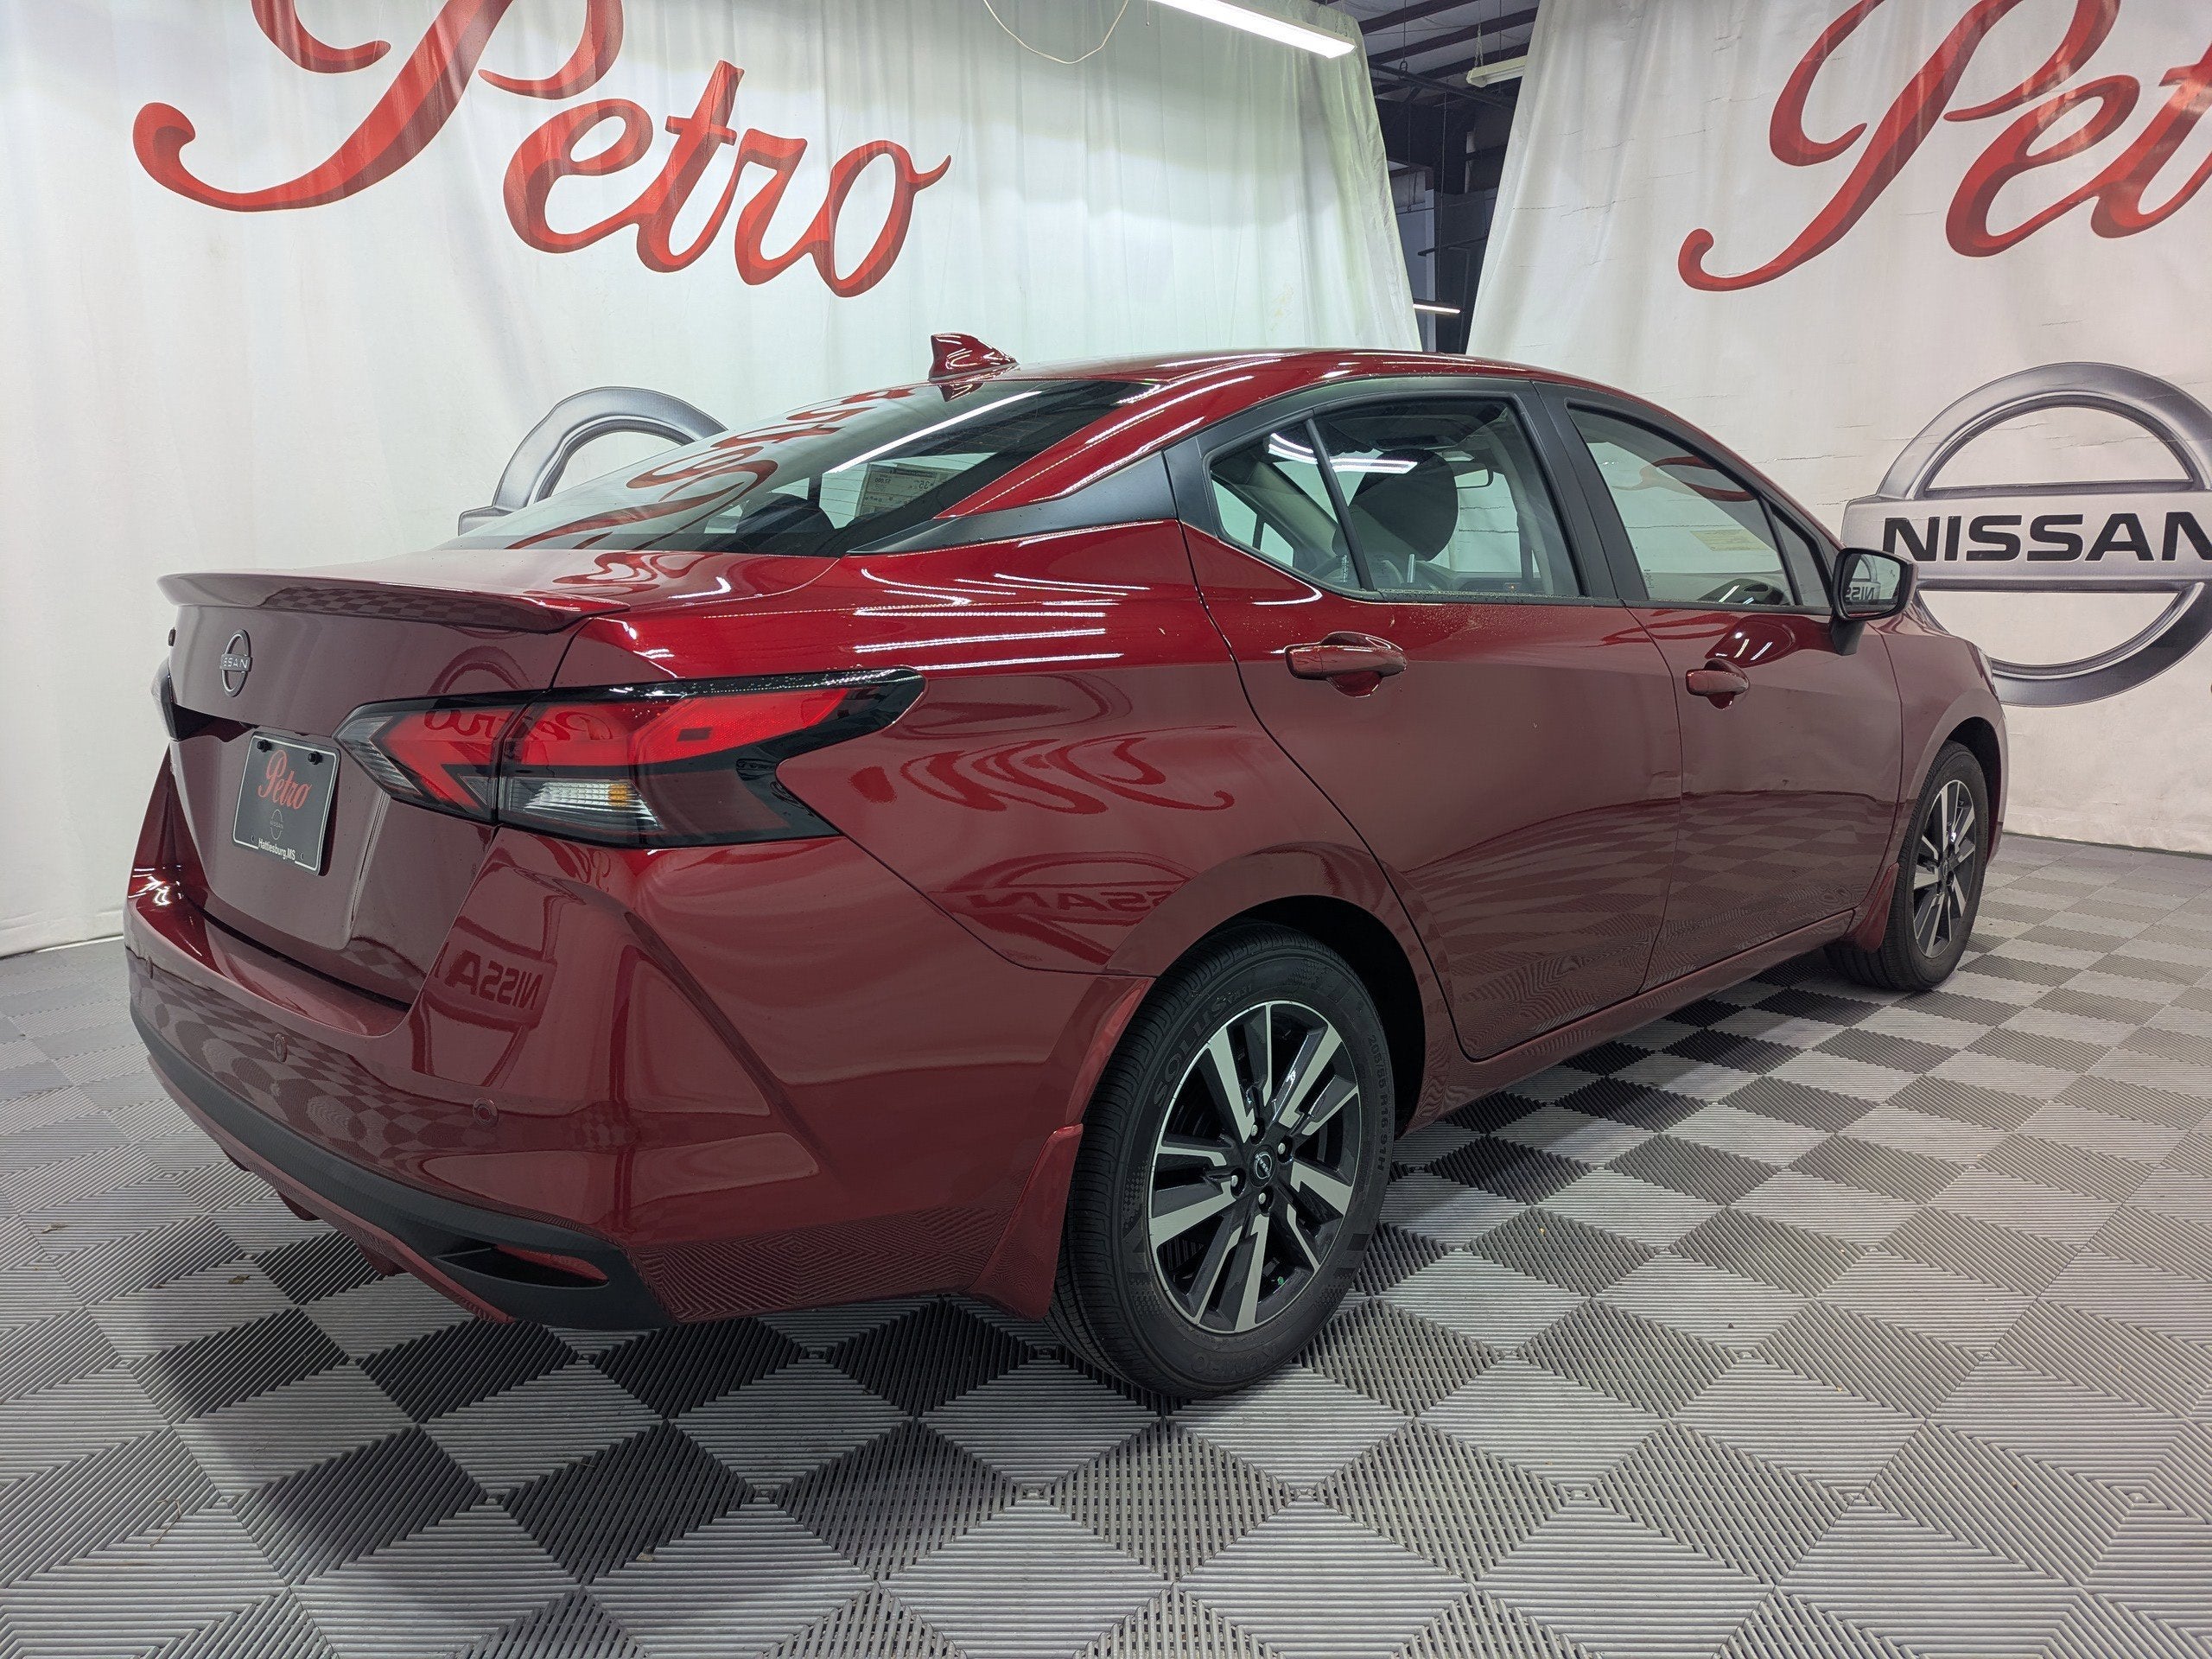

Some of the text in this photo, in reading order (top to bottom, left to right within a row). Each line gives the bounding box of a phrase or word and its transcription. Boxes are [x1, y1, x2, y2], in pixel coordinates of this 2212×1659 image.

[133, 0, 951, 298] Petro
[1883, 511, 2212, 562] NISSAN
[257, 749, 312, 810] Petro
